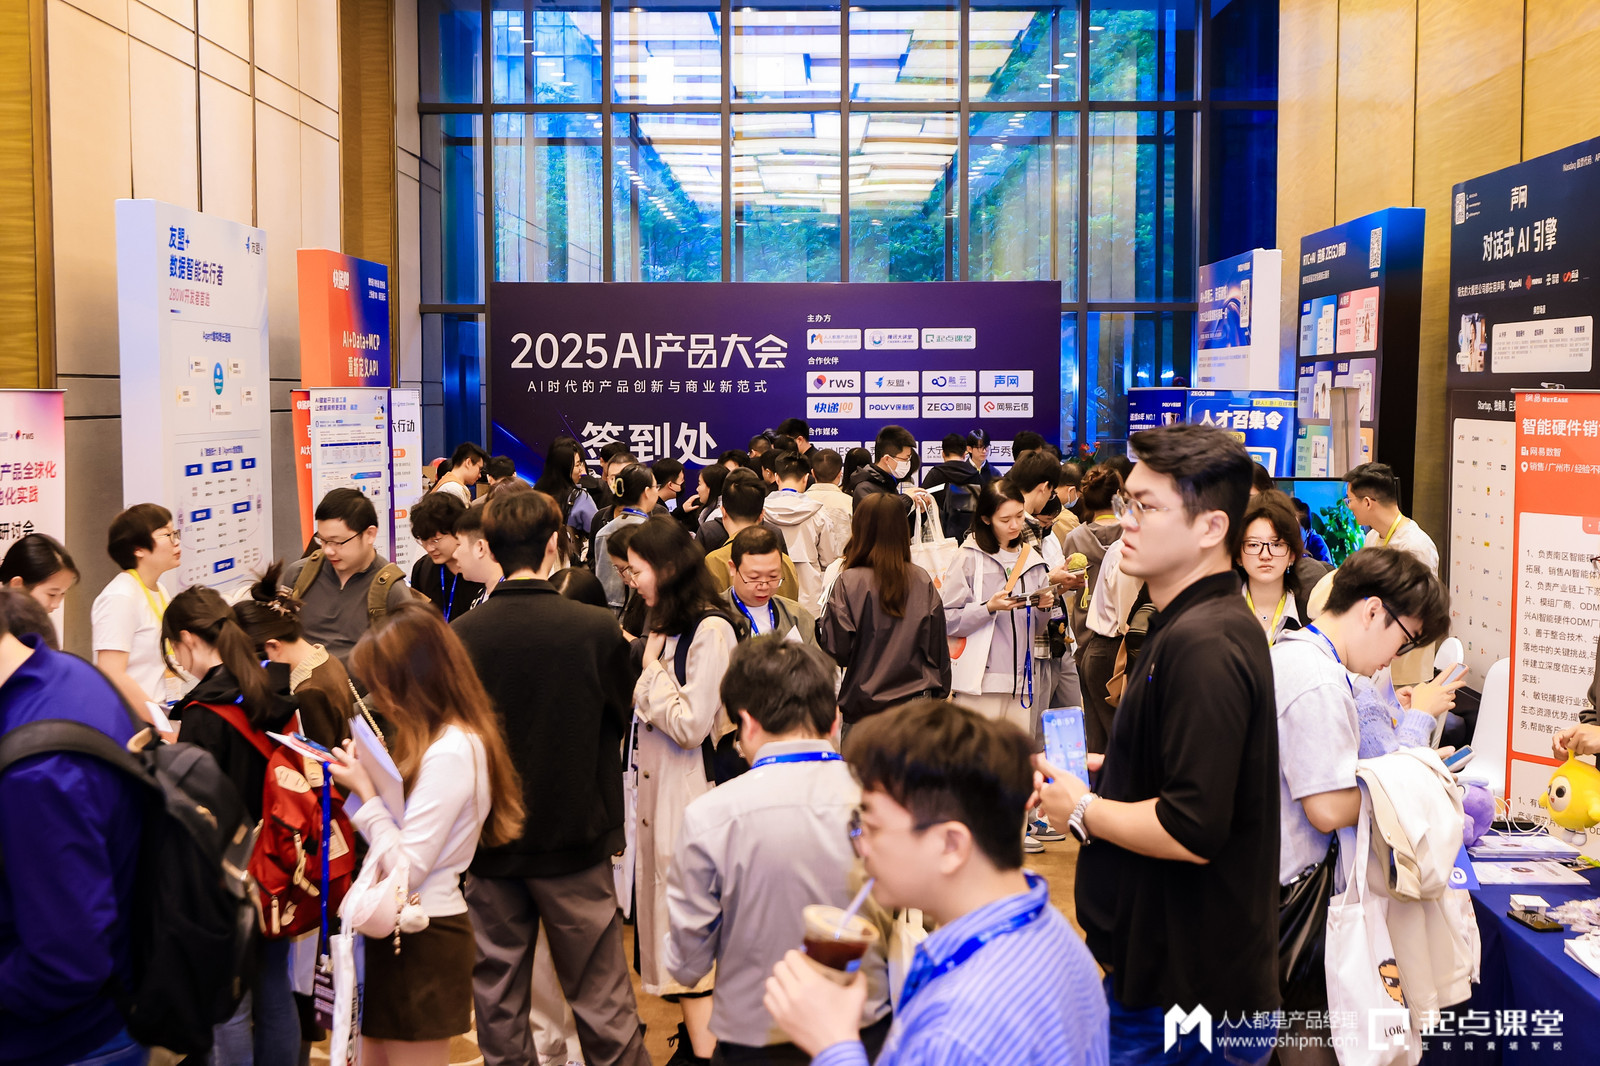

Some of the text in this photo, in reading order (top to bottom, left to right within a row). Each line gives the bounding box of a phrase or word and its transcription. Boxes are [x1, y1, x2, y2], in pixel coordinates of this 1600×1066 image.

[1510, 185, 1528, 211] 声网
[1482, 217, 1558, 262] 对话式 AI 引擎
[169, 254, 224, 286] 数据智能先行者
[807, 314, 831, 324] 主办方
[342, 331, 380, 350] AI+Data+MCP
[511, 332, 788, 370] 2025AI产品大会
[807, 356, 840, 365] 合作伙伴
[528, 380, 768, 394] AI时代的产品创新与商业新范式
[829, 379, 854, 388] rws
[994, 375, 1019, 388] 声网
[814, 402, 854, 413] 快递100
[996, 403, 1029, 412] 网易云信
[1199, 410, 1284, 431] 人才召集令
[1522, 418, 1600, 439] 智能硬件销
[808, 428, 839, 436] 合作媒体
[580, 421, 718, 469] 签到处
[1530, 447, 1561, 458] 网易数智
[0, 461, 57, 482] 产品全球化
[1527, 549, 1598, 563] 1、负责南区智能硬
[1524, 611, 1600, 628] 兴AI智能硬件ODM厂
[1521, 689, 1592, 708] 4、敏锐捕捉行业客
